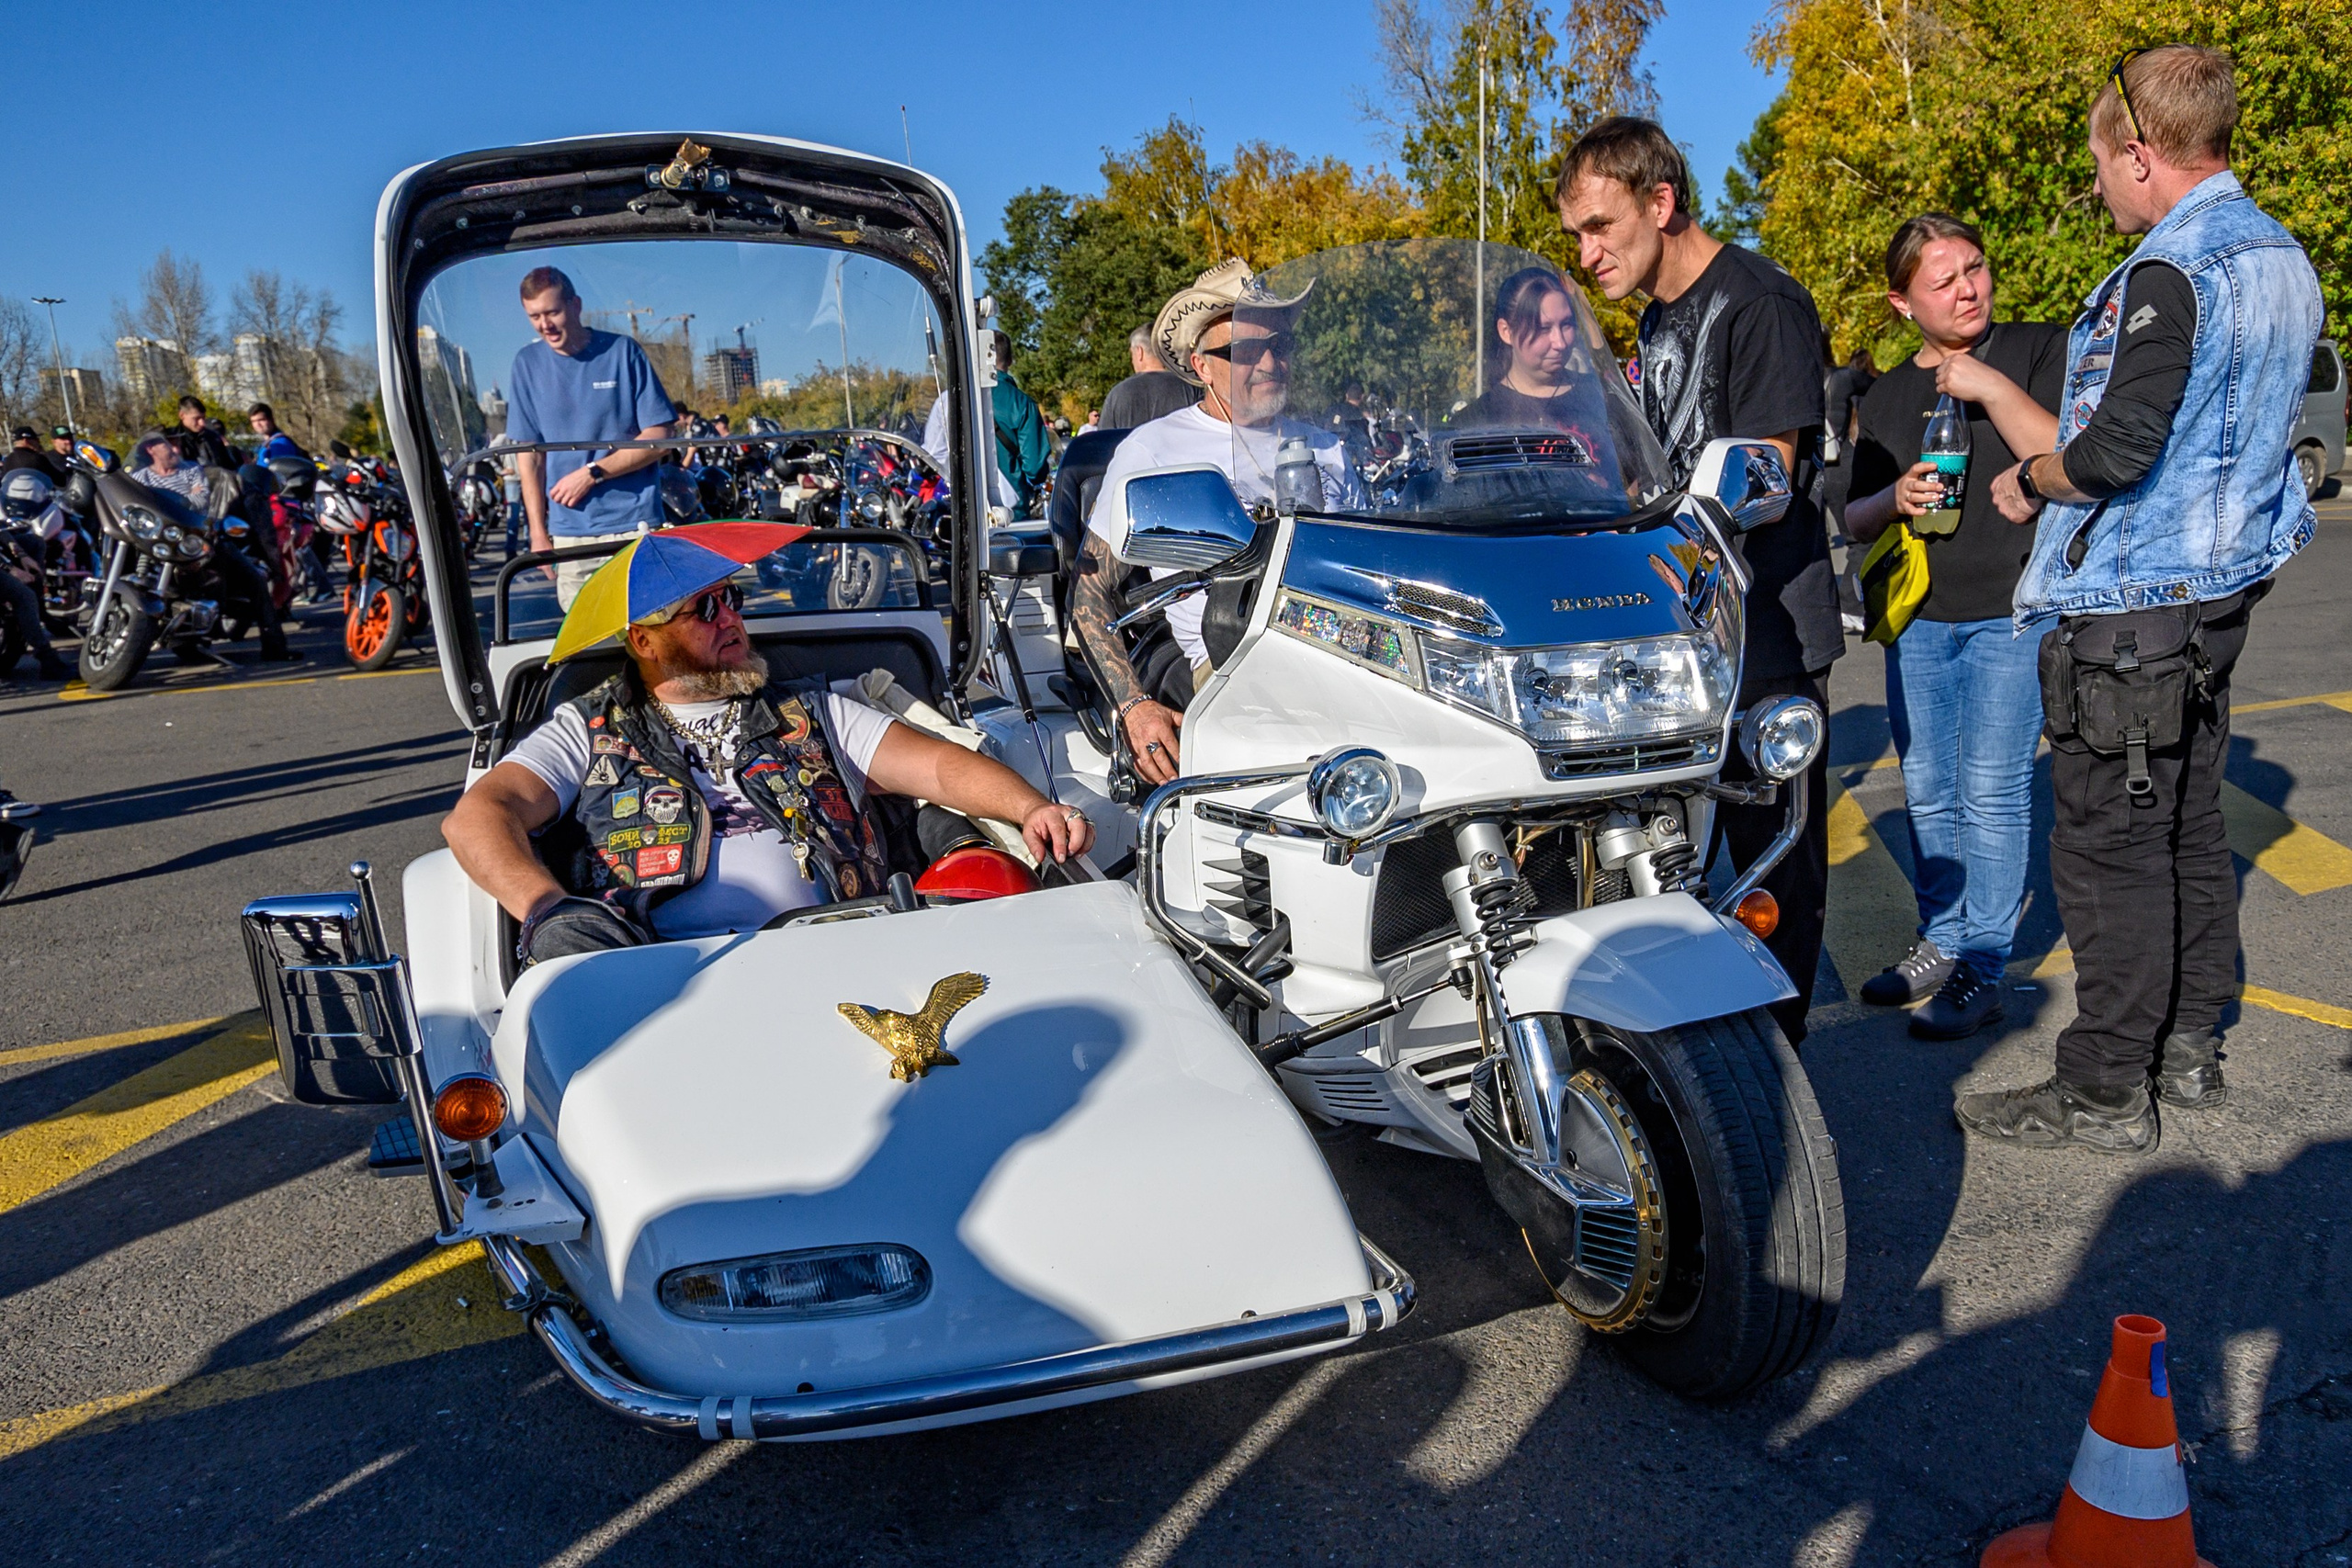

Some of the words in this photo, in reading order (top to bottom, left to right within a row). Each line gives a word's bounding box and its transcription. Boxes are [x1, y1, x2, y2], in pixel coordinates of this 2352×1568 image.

[1551, 592, 1653, 612] HONDA
[610, 829, 640, 846] БОНИ
[628, 840, 642, 849] 20
[657, 837, 672, 845] 25
